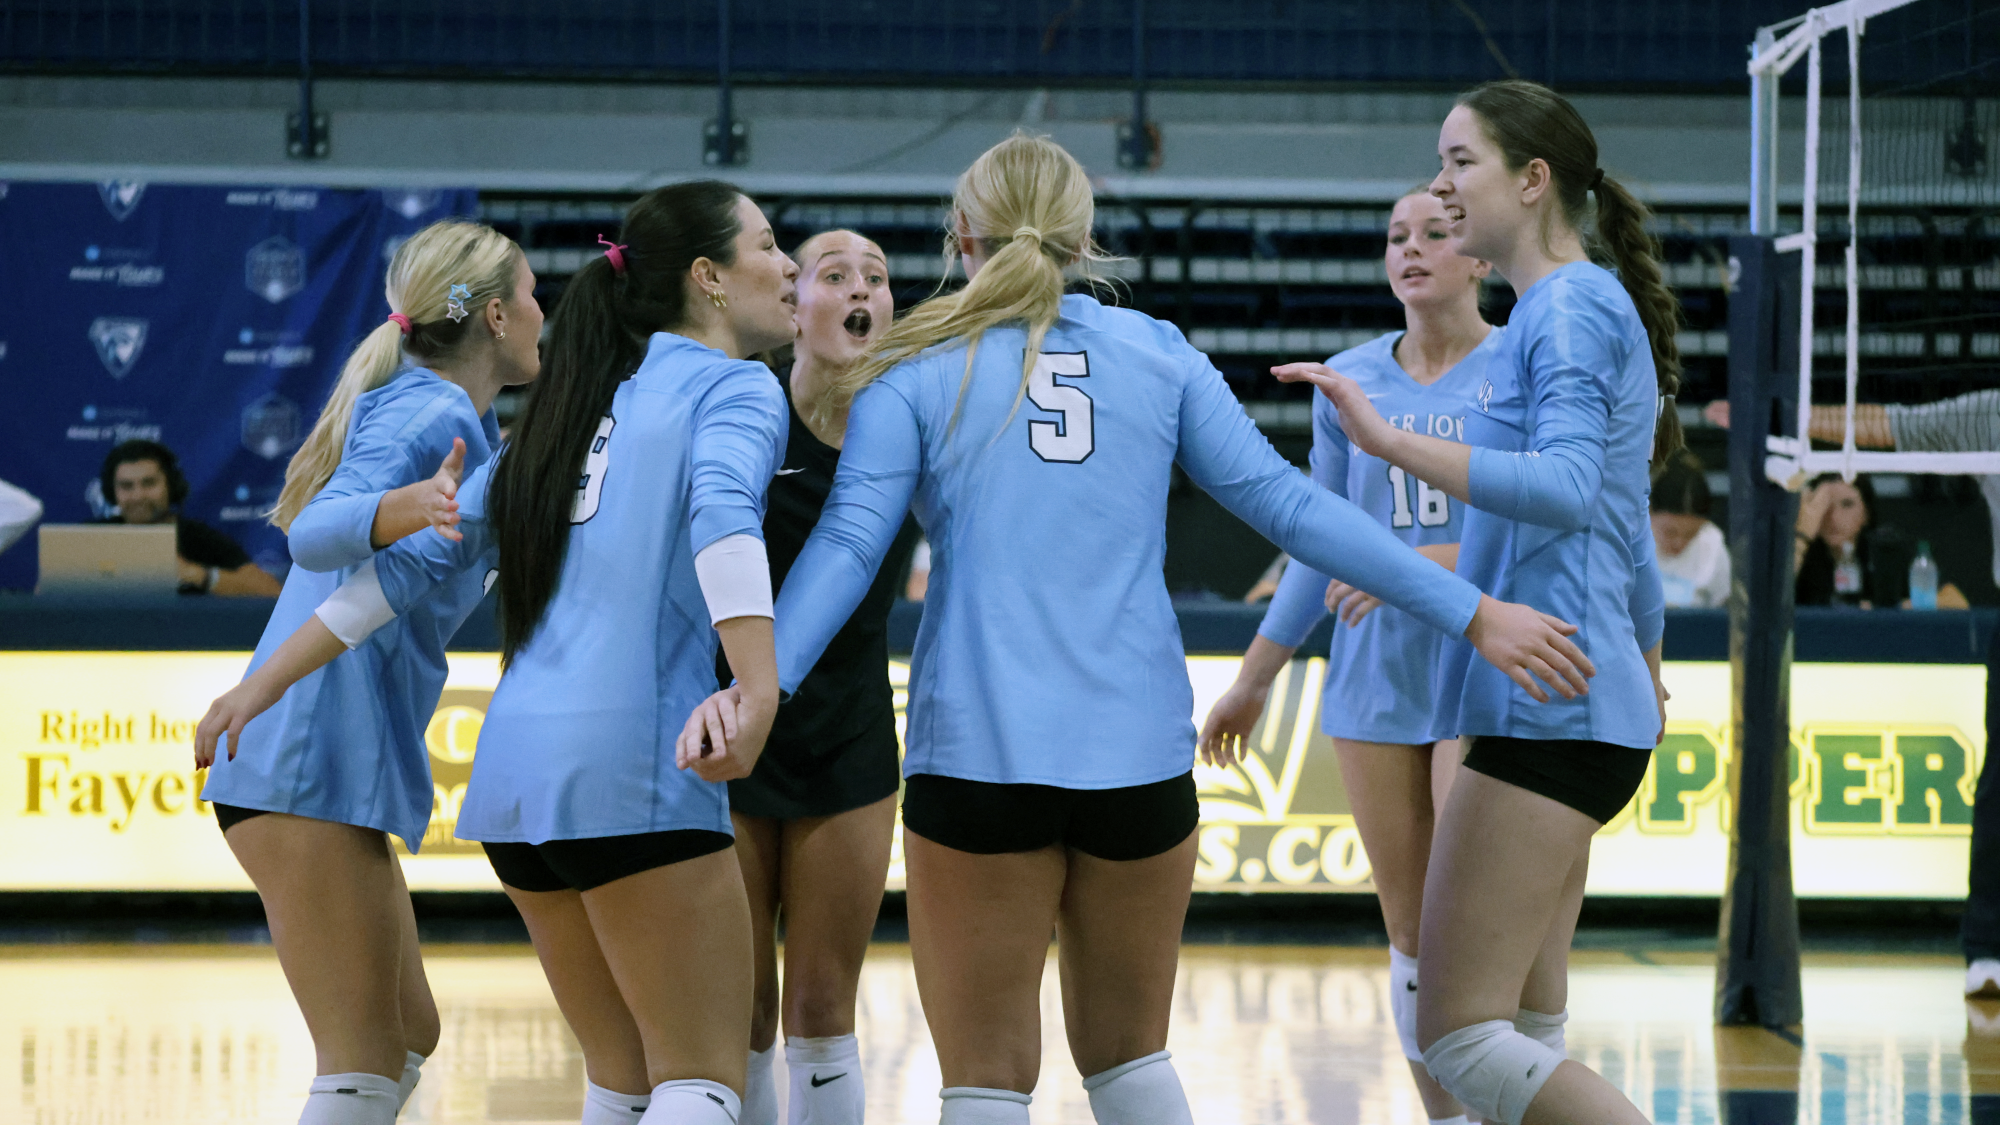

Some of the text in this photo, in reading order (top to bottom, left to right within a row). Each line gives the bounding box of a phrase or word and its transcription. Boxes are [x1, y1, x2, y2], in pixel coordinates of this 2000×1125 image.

[1022, 348, 1096, 464] 5
[39, 711, 136, 747] Right
[20, 754, 213, 831] Fayet
[1612, 721, 1977, 836] PER
